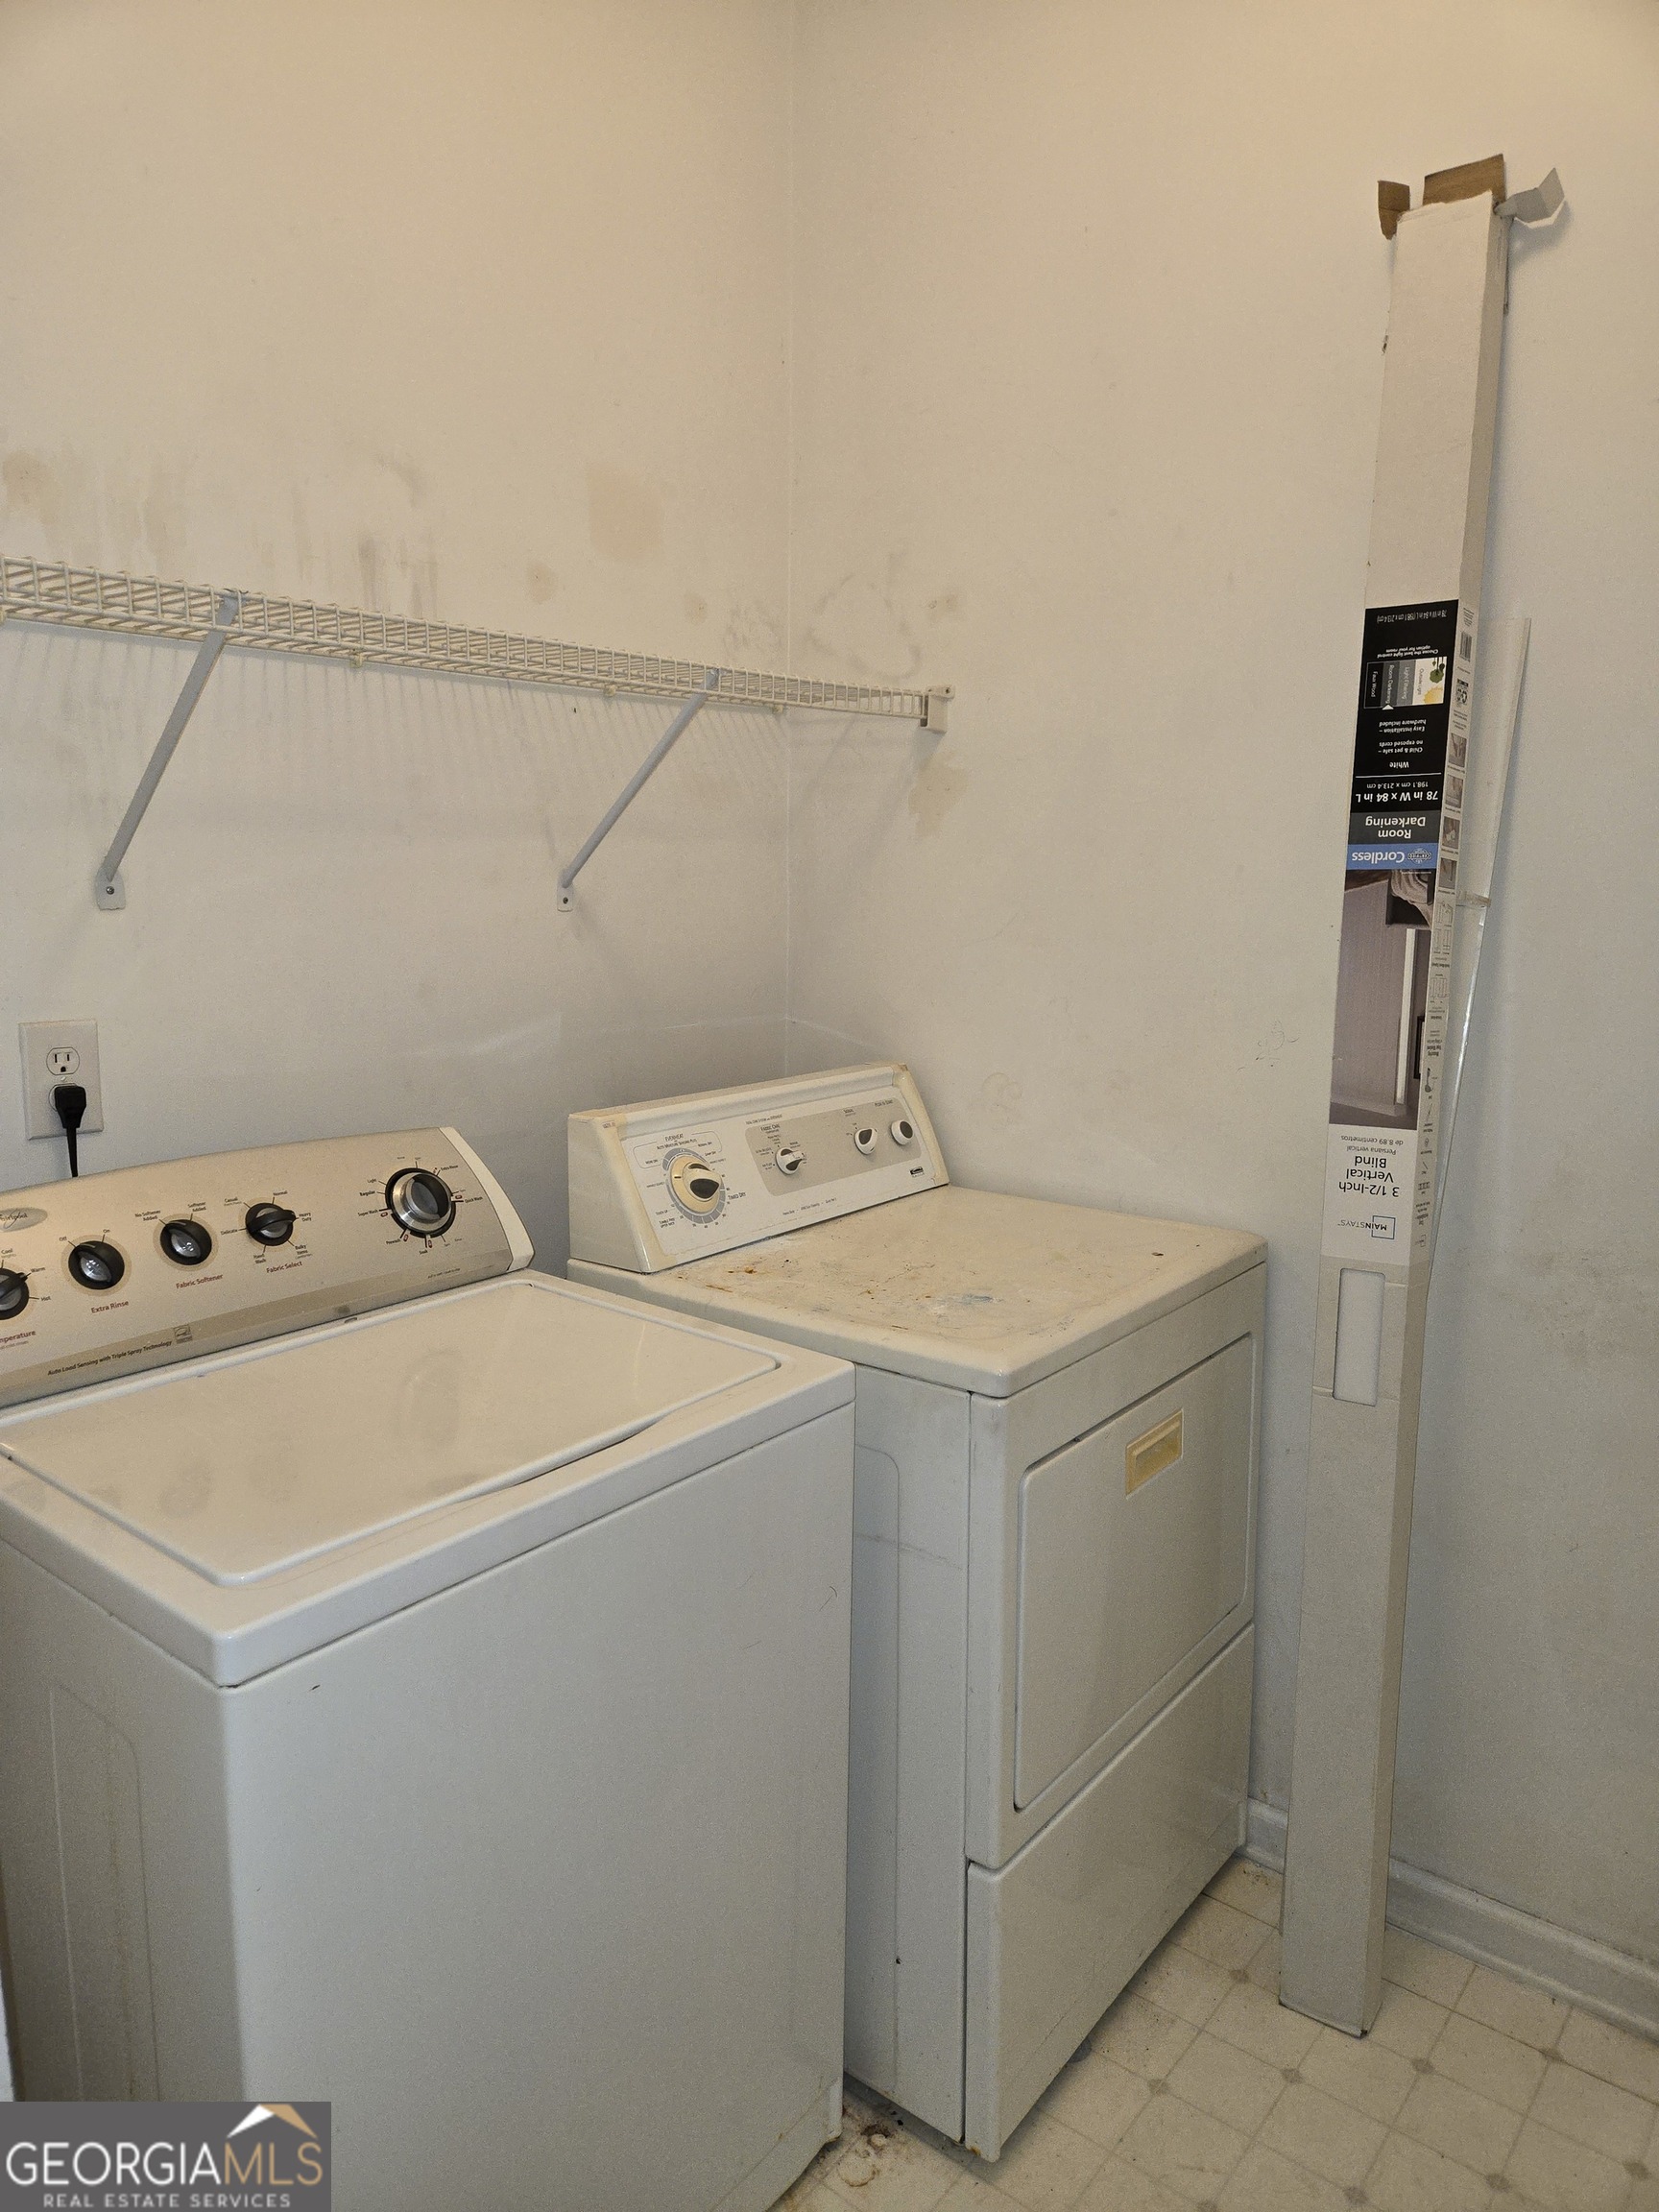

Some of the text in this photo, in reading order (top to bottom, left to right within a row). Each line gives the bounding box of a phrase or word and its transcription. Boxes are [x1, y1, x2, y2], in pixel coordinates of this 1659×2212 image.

[1356, 794, 1361, 803] L
[1364, 793, 1373, 803] in
[1377, 793, 1388, 802] 84
[1400, 792, 1410, 802] W
[1413, 792, 1423, 801] in
[1427, 791, 1438, 801] 78
[1365, 816, 1426, 829] Darkening
[1378, 830, 1411, 839] Room
[1352, 851, 1405, 864] Cordless
[1355, 1156, 1386, 1168] Blind
[1346, 1168, 1393, 1183] Vertical
[1338, 1182, 1400, 1197] 3 1/2-Inch
[1340, 1220, 1387, 1231] MAINSTAYS
[267, 1264, 284, 1273] Fabric
[197, 1274, 223, 1284] Softener
[110, 1300, 129, 1309] Rinse
[77, 1359, 98, 1368] Sensing
[143, 1340, 172, 1352] Technology
